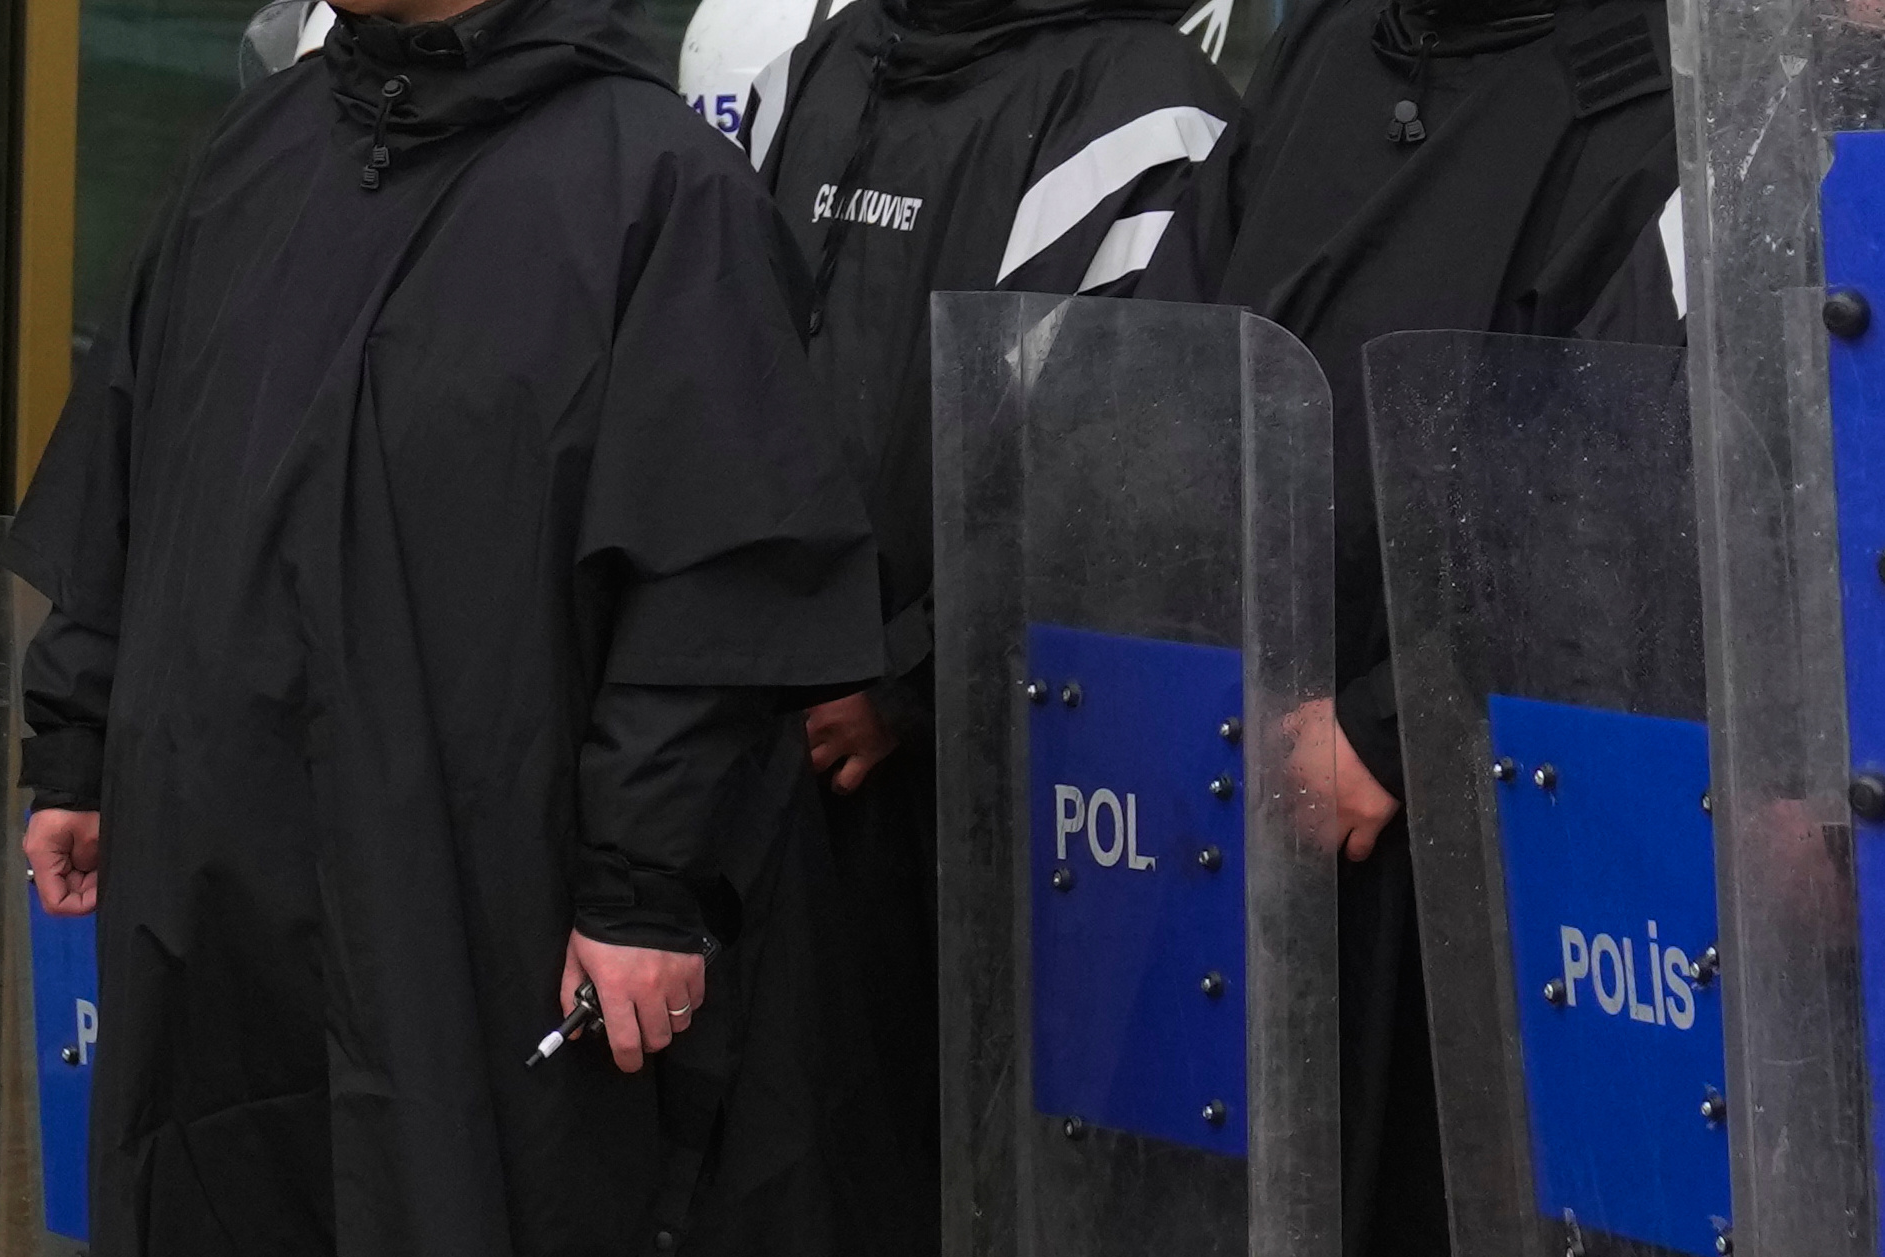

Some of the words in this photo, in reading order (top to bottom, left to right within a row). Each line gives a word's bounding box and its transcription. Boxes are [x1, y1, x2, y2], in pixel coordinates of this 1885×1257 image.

[857, 189, 924, 232] KUVVET
[1054, 783, 1159, 872] POL
[1560, 919, 1696, 1030] POLİS
[75, 998, 99, 1066] P
